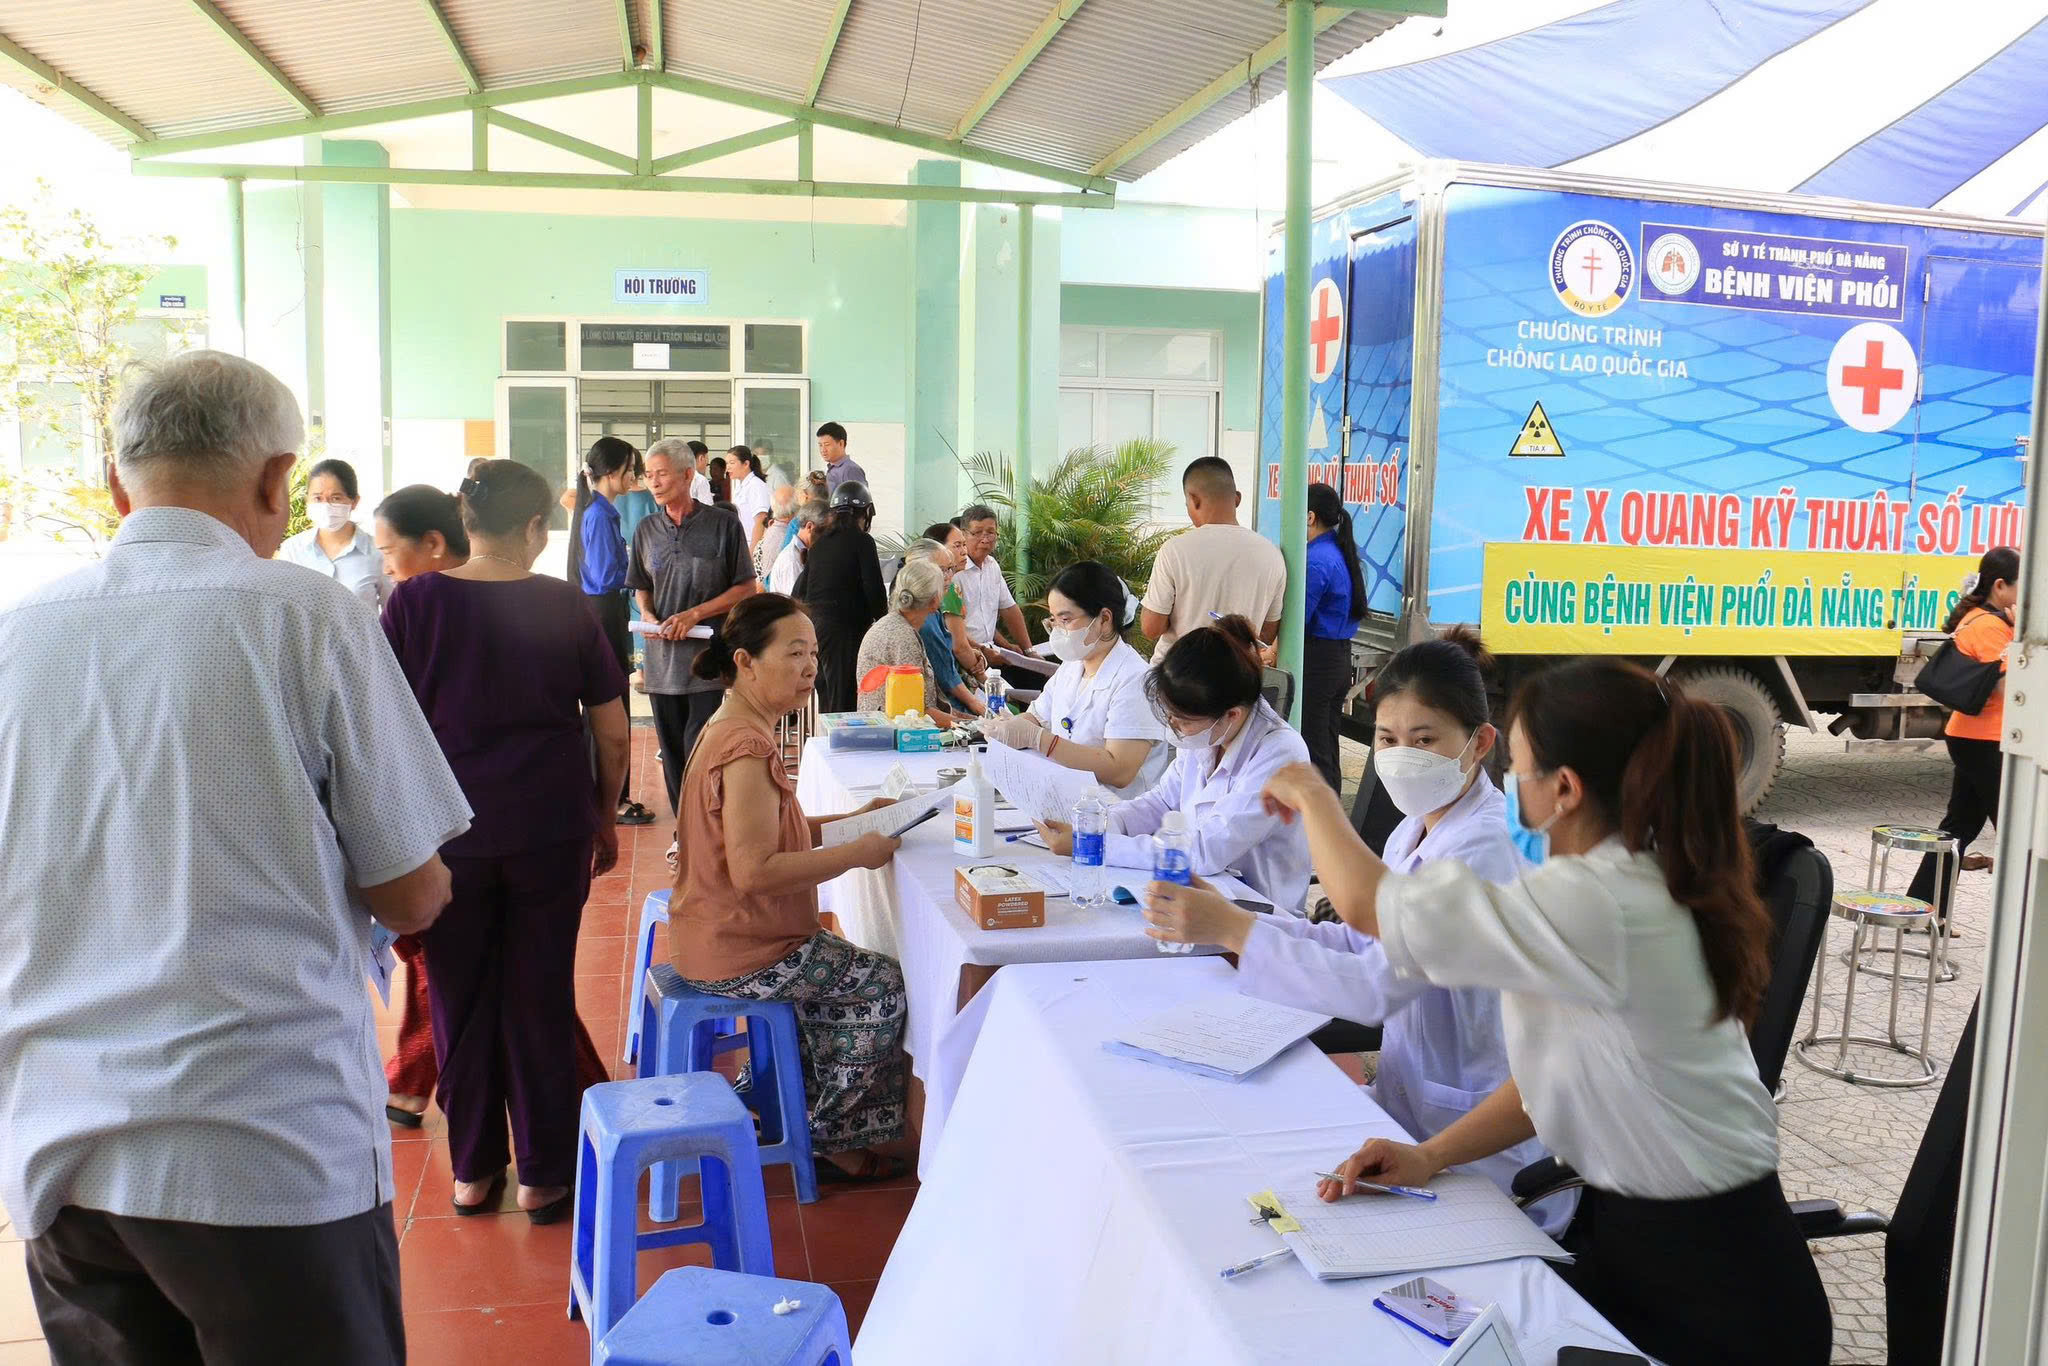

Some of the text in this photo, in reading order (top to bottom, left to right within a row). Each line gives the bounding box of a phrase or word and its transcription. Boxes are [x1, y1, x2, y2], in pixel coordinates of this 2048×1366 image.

[1562, 229, 1583, 247] TRÌNH
[1583, 225, 1609, 238] CHỐNG
[1608, 235, 1623, 250] LAO
[1619, 274, 1629, 288] GIA
[1742, 244, 1750, 258] Y
[1752, 242, 1766, 259] TẾ
[1769, 246, 1807, 263] THÀNH
[1810, 247, 1833, 265] PHỐ
[624, 276, 696, 297] HỘI TRƯỜNG
[1705, 265, 1899, 308] BỆNH VIỆN PHỔI
[1518, 320, 1662, 347] CHƯƠNG TRÌNH
[1487, 343, 1688, 378] CHỐNG LAO QUỐC GIA
[1267, 463, 1280, 499] XE
[1344, 455, 1379, 513] THUẬT
[1380, 448, 1399, 505] SỐ
[1523, 487, 1572, 541] XE
[1582, 489, 1610, 543] X
[1620, 491, 1740, 546] QUANG
[1751, 487, 1796, 548] KỸ
[1917, 486, 1967, 554] SỐ
[1505, 571, 1576, 624] CÙNG
[1584, 574, 1652, 634] BỆNH
[1660, 576, 1714, 635] VIỆN
[1721, 569, 1776, 626] PHỔI
[1782, 577, 1813, 627] ĐÀ
[1821, 573, 1883, 628] NẴNG
[1892, 576, 1938, 629] TẦM
